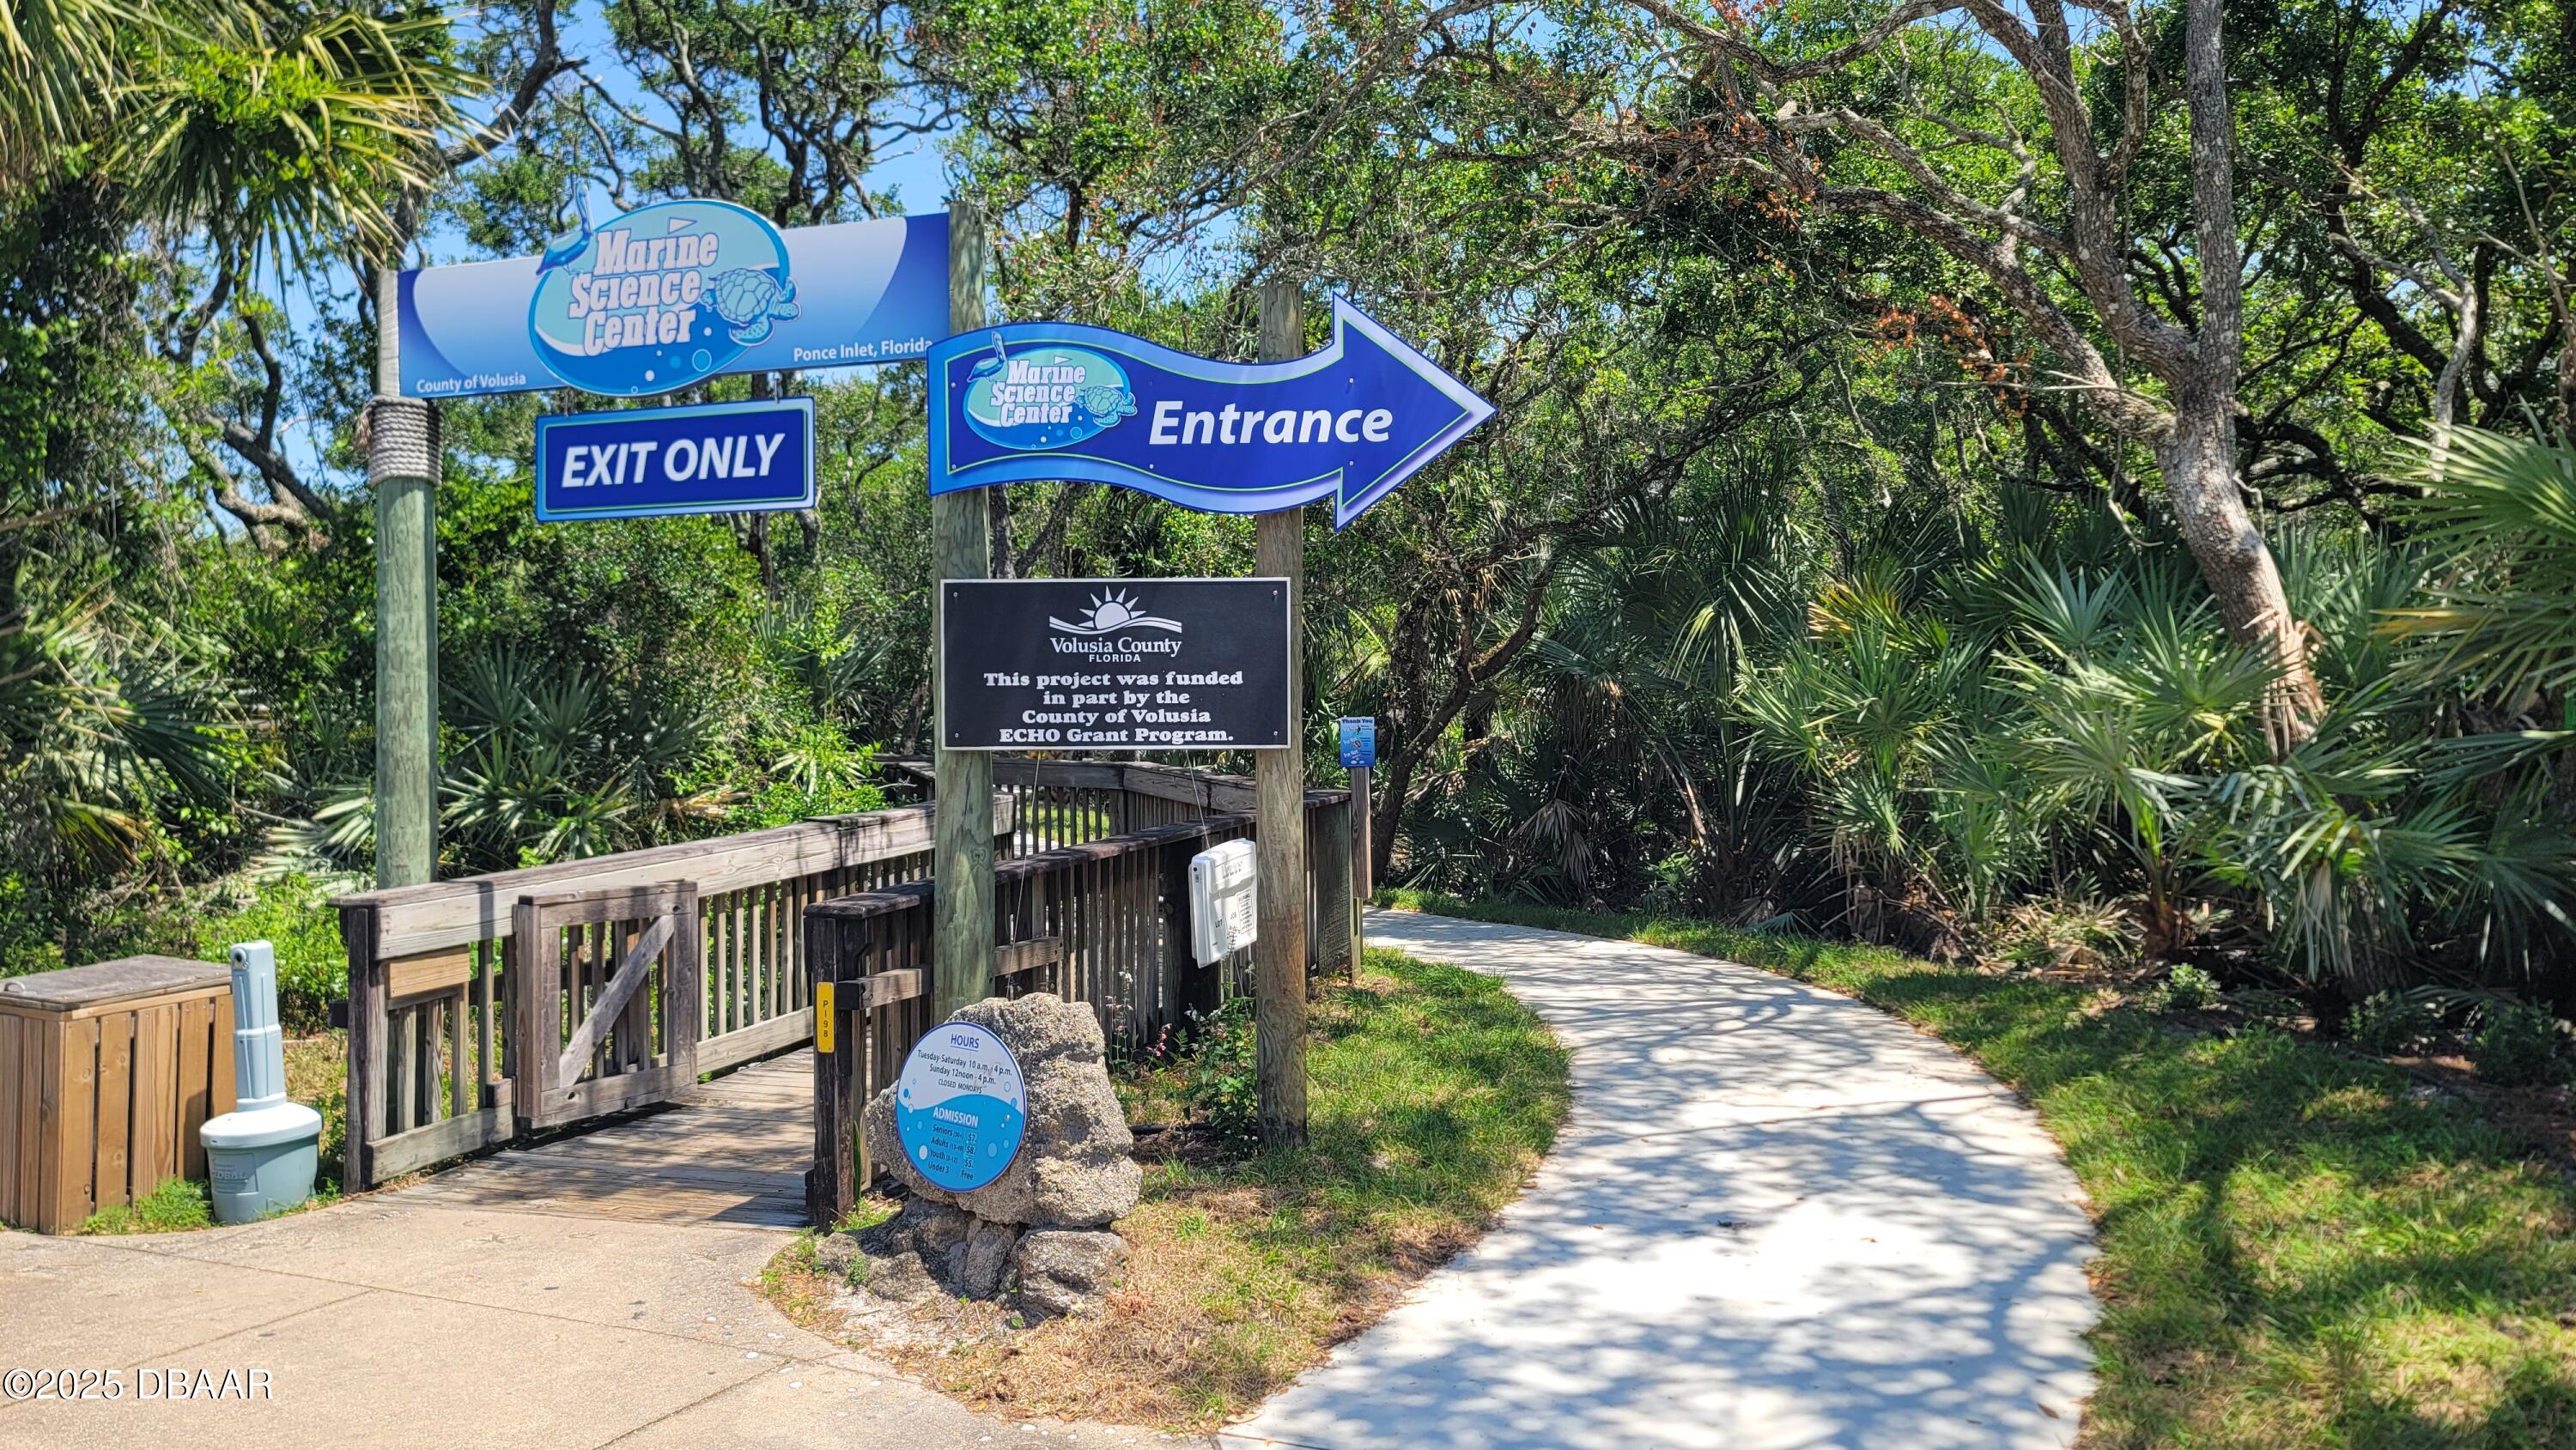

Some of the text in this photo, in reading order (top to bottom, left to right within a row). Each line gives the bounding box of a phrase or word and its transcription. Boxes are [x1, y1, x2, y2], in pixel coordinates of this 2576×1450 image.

[593, 228, 719, 276] Marine
[568, 270, 702, 319] Science
[584, 306, 696, 356] Center
[793, 337, 933, 361] Ponce Inlet, Florida
[416, 371, 526, 393] County of Volusia
[1006, 360, 1086, 385] Marine
[990, 381, 1075, 406] Science
[1000, 402, 1072, 427] Center
[1149, 401, 1393, 446] Entrance
[561, 433, 786, 488] EXIT ONLY
[1049, 636, 1182, 658] Volusia County
[1089, 654, 1141, 663] FLORIDA
[983, 670, 1243, 689] This project was funded
[1042, 690, 1190, 708] in part by the
[1022, 708, 1212, 726] County of Volusia
[999, 728, 1234, 745] ECHO Grant Program.
[951, 1033, 980, 1049] HOURS
[917, 1049, 967, 1068] Tuesday-Saturday
[969, 1059, 976, 1068] 10
[977, 1063, 990, 1071] a.m.
[999, 1067, 1012, 1077] p.m.
[929, 1064, 951, 1077] Sunday
[952, 1068, 974, 1080] 12noon
[978, 1073, 982, 1082] 4
[982, 1076, 996, 1085] p.m.
[938, 1078, 982, 1094] CLOSED MONDAYS
[933, 1107, 979, 1127] ADMISSION
[933, 1124, 953, 1137] Seniors
[931, 1136, 949, 1148] Adults
[930, 1149, 945, 1161] Youth
[928, 1162, 945, 1173] Under
[961, 1169, 974, 1180] Free
